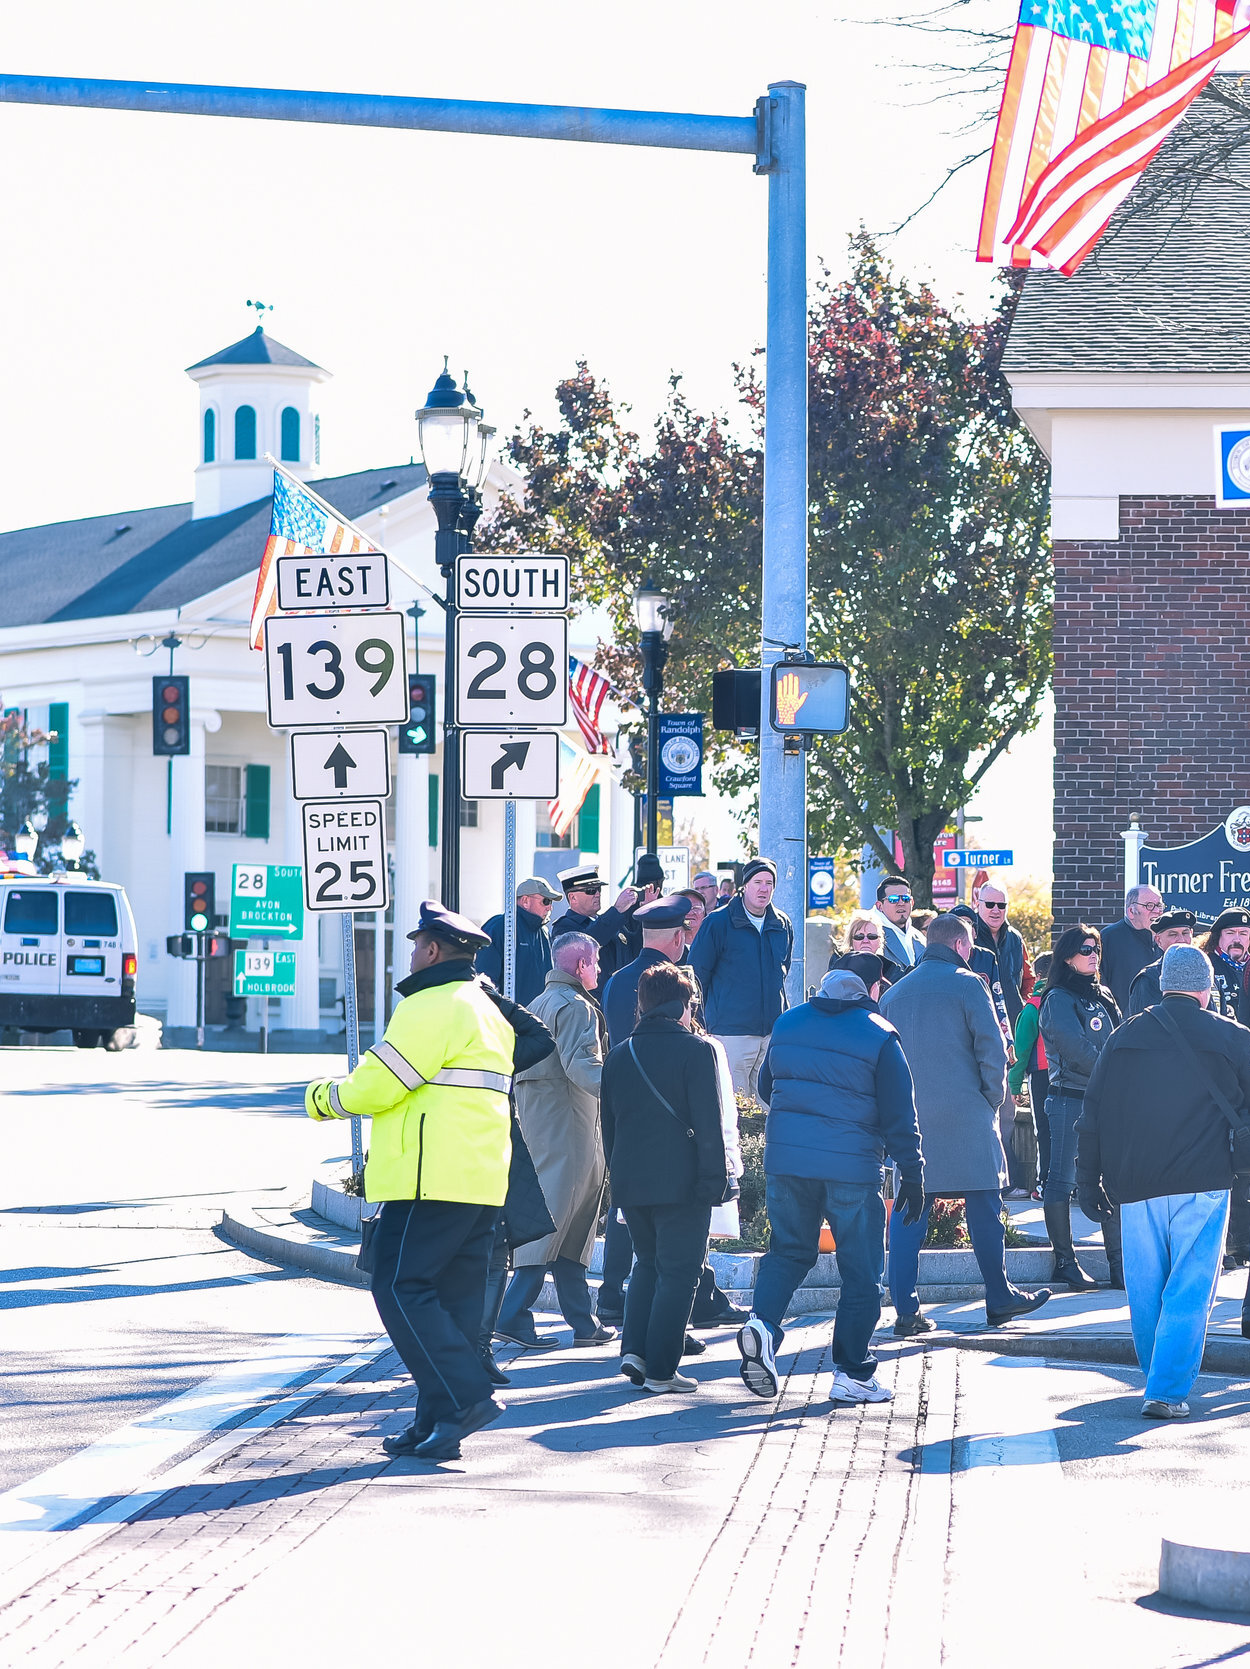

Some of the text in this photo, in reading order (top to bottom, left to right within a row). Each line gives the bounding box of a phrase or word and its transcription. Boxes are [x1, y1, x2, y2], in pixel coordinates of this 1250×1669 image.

[296, 566, 372, 598] EAST
[464, 568, 560, 598] SOUTH
[277, 638, 395, 701] 139
[467, 641, 557, 701] 28
[660, 725, 701, 735] Randolph
[687, 719, 695, 727] of
[669, 782, 692, 790] Square
[309, 811, 377, 829] SPEED
[317, 835, 370, 852] LIMIT
[665, 855, 686, 863] LANE
[964, 852, 1000, 865] Turner
[238, 873, 264, 889] 28
[314, 860, 377, 902] 25
[1143, 861, 1214, 894] Turner
[255, 900, 280, 909] AVON
[241, 910, 293, 921] BROCKTON
[3, 952, 57, 966] POLICE
[248, 957, 271, 970] 139
[247, 983, 295, 992] HOLBROOK
